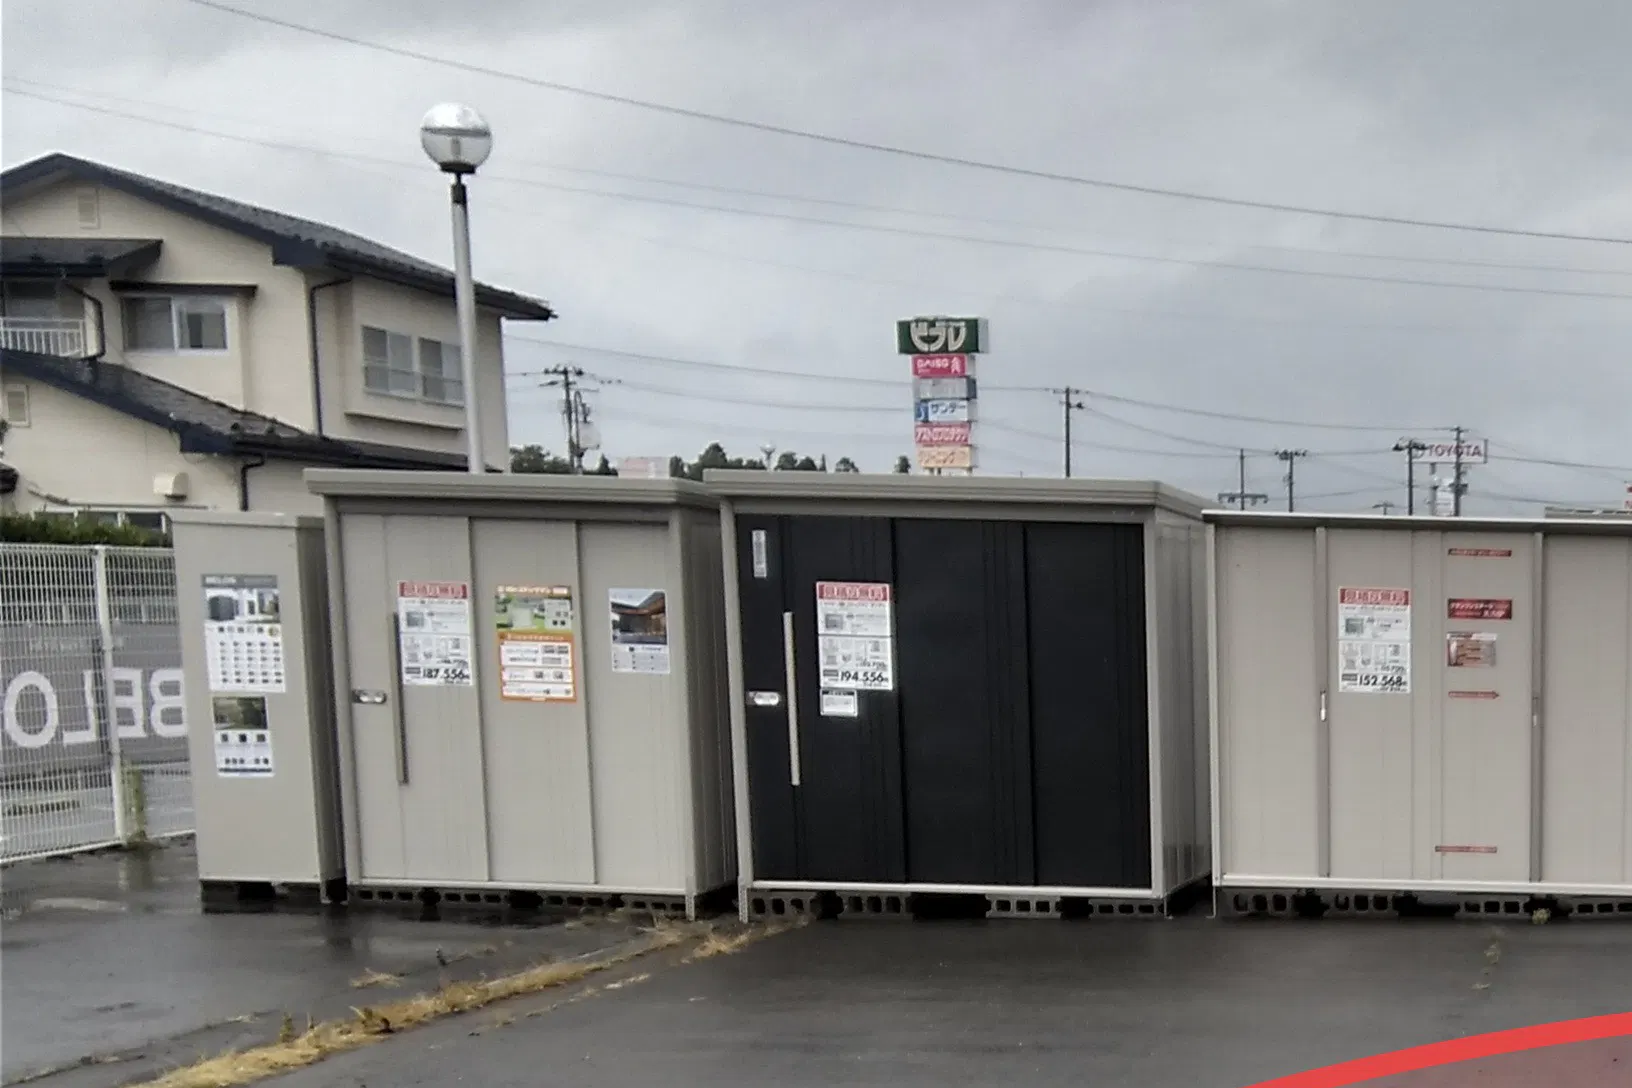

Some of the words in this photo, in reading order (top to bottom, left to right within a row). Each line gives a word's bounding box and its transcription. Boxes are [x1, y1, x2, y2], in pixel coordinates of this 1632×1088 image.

[917, 358, 949, 369] DAISO
[931, 402, 966, 414] サンデー
[1428, 443, 1483, 457] TOYOTA
